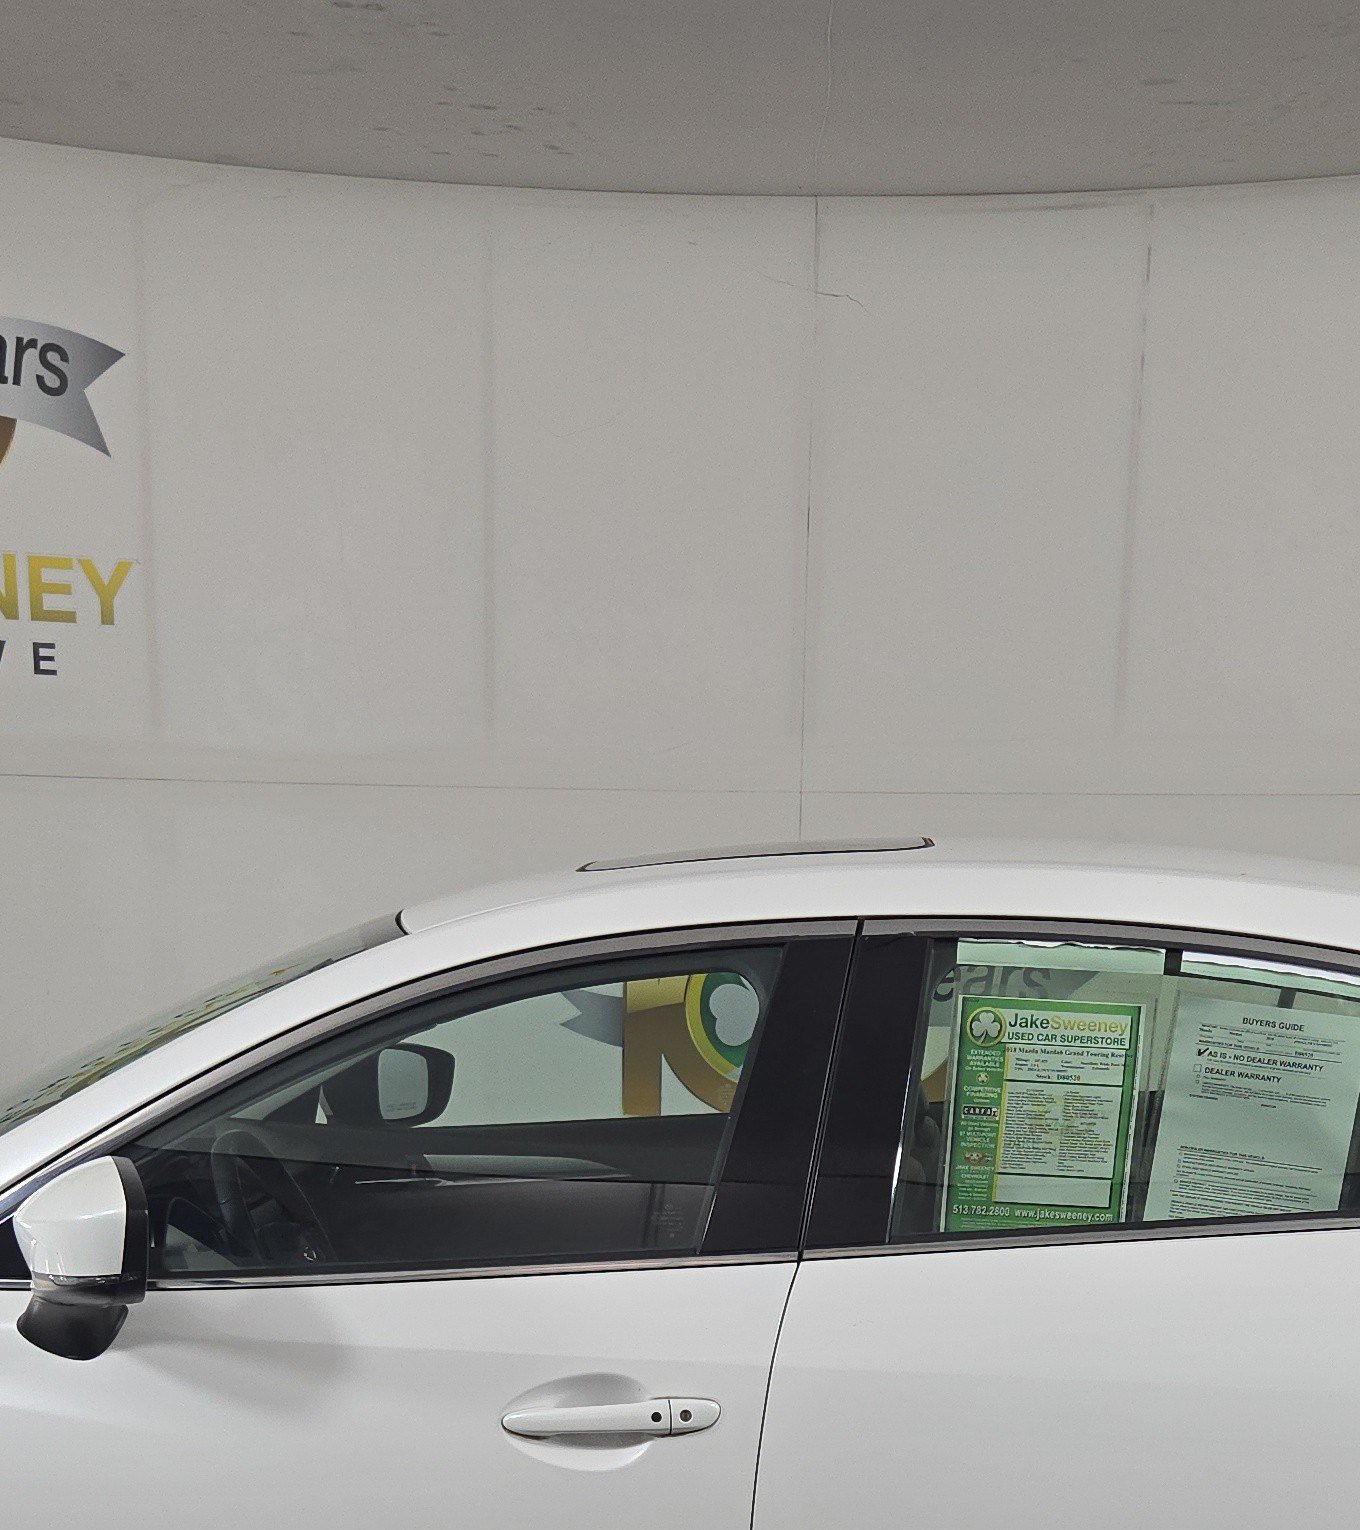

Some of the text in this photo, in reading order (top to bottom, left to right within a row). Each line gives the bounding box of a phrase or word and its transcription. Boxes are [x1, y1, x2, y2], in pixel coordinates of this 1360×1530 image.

[1008, 1013, 1128, 1036] JakeSweeney
[1242, 1017, 1305, 1032] BUYERS GUIDE
[1007, 1032, 1126, 1046] USED CAR SUPERSTORE
[1207, 1050, 1219, 1058] AS
[1219, 1051, 1227, 1059] IS
[1233, 1053, 1245, 1062] NO
[1246, 1055, 1278, 1067] DEALER
[1279, 1060, 1324, 1072] WARRANTY
[1204, 1066, 1236, 1078] DEALER
[1237, 1071, 1282, 1083] WARRANTY
[953, 1204, 1113, 1222] 513.782.2800 www.jakesweeney.com
